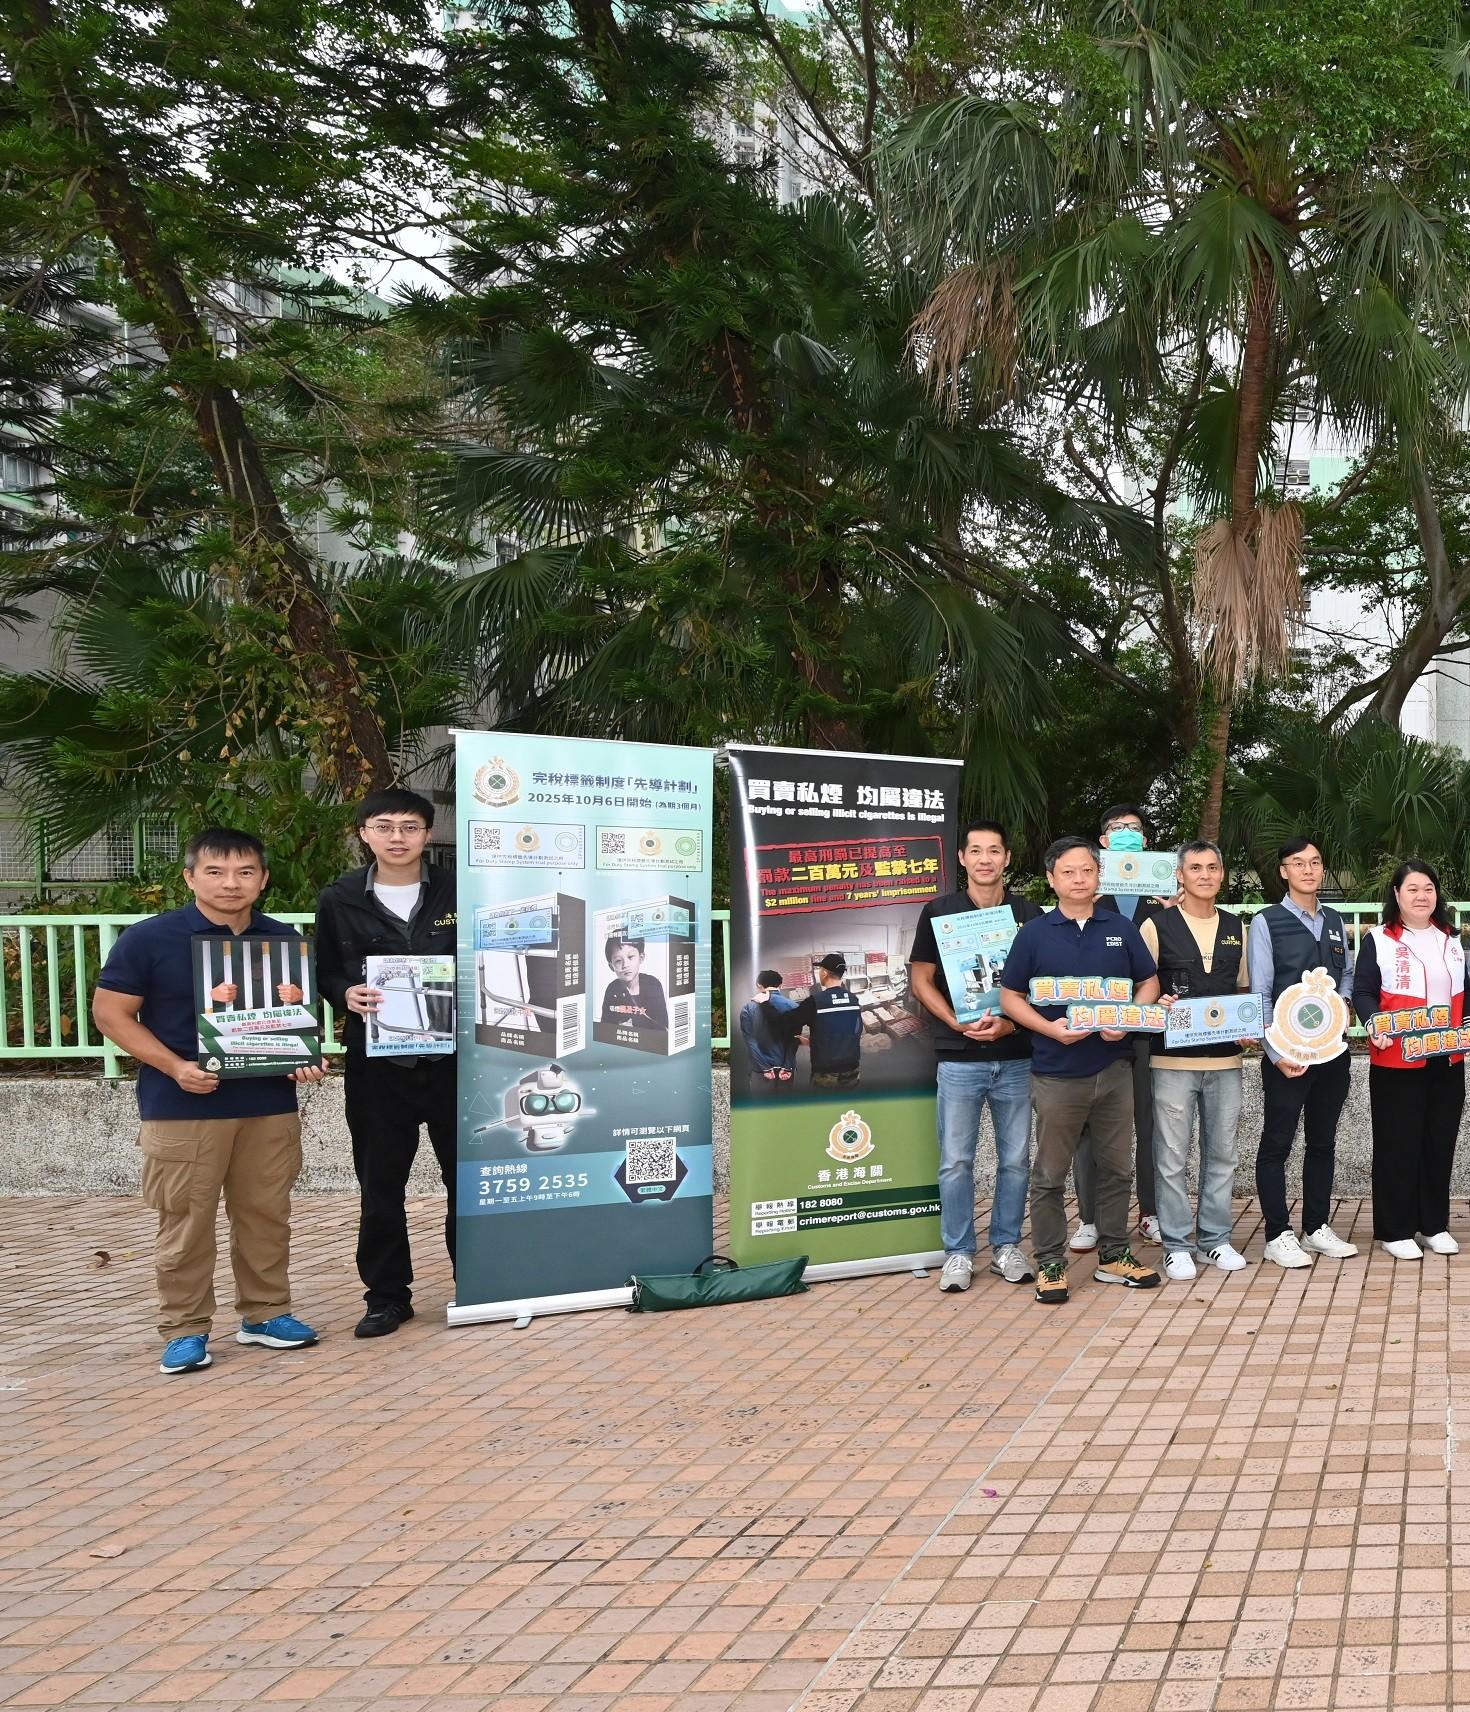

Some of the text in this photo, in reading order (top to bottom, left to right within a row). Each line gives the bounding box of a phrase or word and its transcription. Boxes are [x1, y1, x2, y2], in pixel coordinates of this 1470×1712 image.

[532, 772, 698, 794] 完稅標籤制度「先導計劃」
[528, 792, 651, 808] 2025年10月6日開始
[748, 779, 944, 809] 買賣私煙 均屬違法
[748, 804, 944, 823] Buying or selling illicit cigarettes is illegal
[788, 845, 907, 864] 最高刑罰已提高至
[757, 858, 939, 884] 罰款二百萬元及監禁七年
[760, 888, 776, 897] The
[778, 886, 822, 895] maximum
[824, 883, 855, 894] penalty
[857, 881, 872, 889] has
[873, 880, 894, 888] been
[895, 878, 919, 887] raised
[765, 898, 777, 908] $2
[779, 896, 809, 907] million
[810, 895, 828, 904] fine
[847, 892, 852, 900] 7
[854, 890, 880, 901] years'
[881, 885, 938, 897] imprisonment
[1034, 978, 1131, 1001] 買賣私煙
[1072, 1004, 1167, 1028] 均屬違法
[1374, 1007, 1449, 1034] 買賣私煙
[613, 1125, 690, 1137] 詳情可瀏覽以下網頁
[480, 1163, 528, 1177] 查詢熱線
[818, 1165, 883, 1183] 香港海關
[479, 1173, 589, 1195] 3759 2535
[862, 1177, 893, 1186] Department
[800, 1197, 843, 1209] 182 8080
[800, 1203, 941, 1226] crimereport@customs.gov.hk
